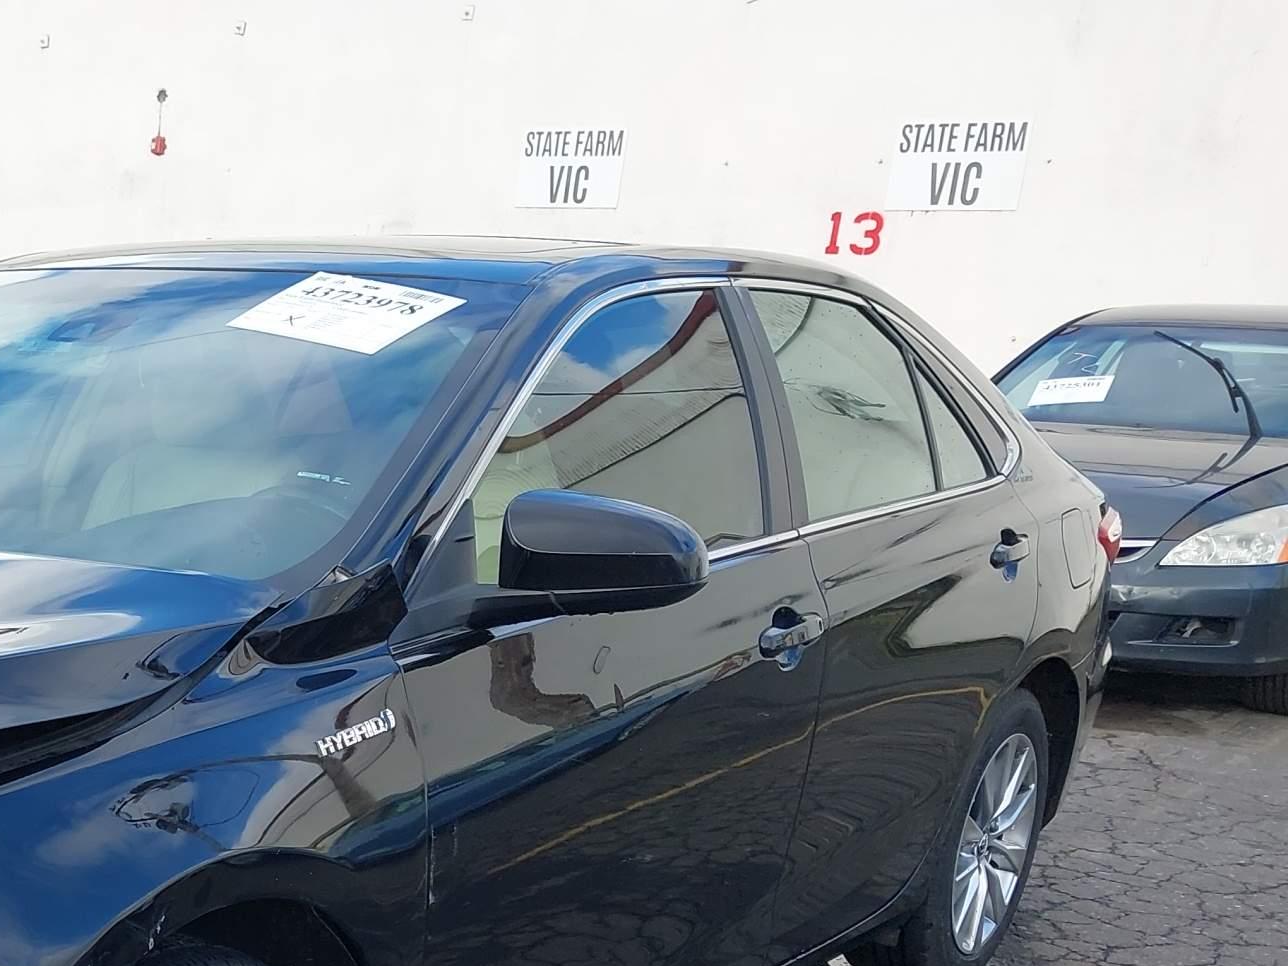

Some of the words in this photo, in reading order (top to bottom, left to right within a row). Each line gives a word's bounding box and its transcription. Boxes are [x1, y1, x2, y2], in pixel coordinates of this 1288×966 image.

[524, 130, 571, 157] STATE
[574, 129, 624, 157] FARM
[899, 123, 961, 154] STATE
[963, 121, 1029, 153] FARM
[549, 165, 590, 204] VIC
[929, 161, 983, 206] VIC
[824, 211, 885, 256] 13
[301, 286, 424, 315] 43723978
[316, 716, 388, 758] HYBRID
